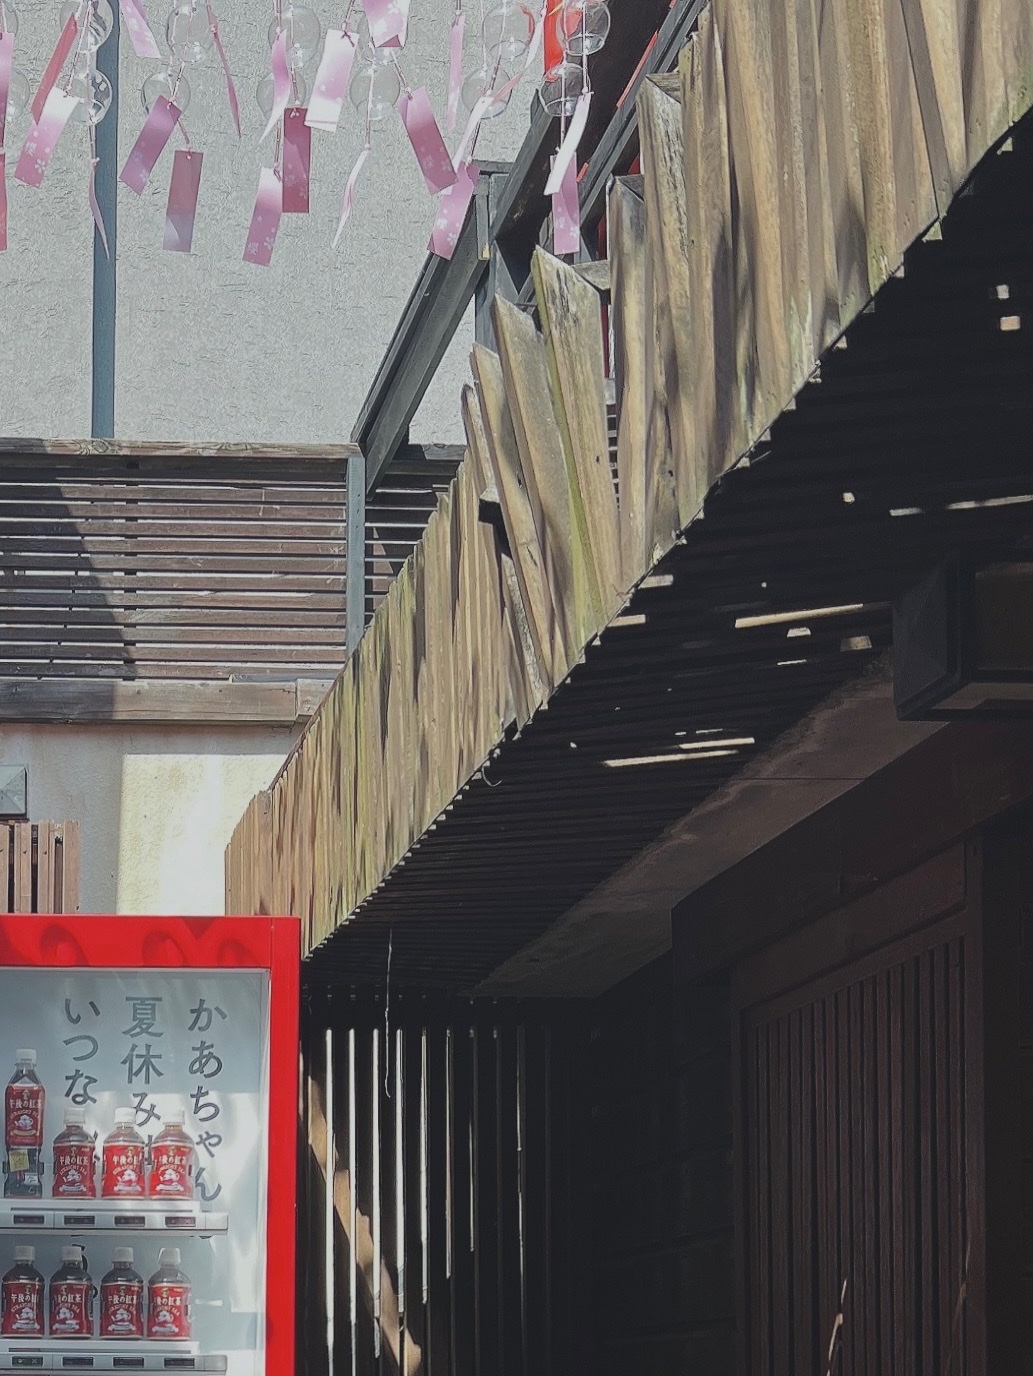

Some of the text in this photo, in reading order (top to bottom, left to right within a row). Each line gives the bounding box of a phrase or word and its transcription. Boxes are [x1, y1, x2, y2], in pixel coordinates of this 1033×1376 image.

[187, 998, 227, 1202] かあちゃん
[59, 1155, 89, 1165] 午後の紅茶
